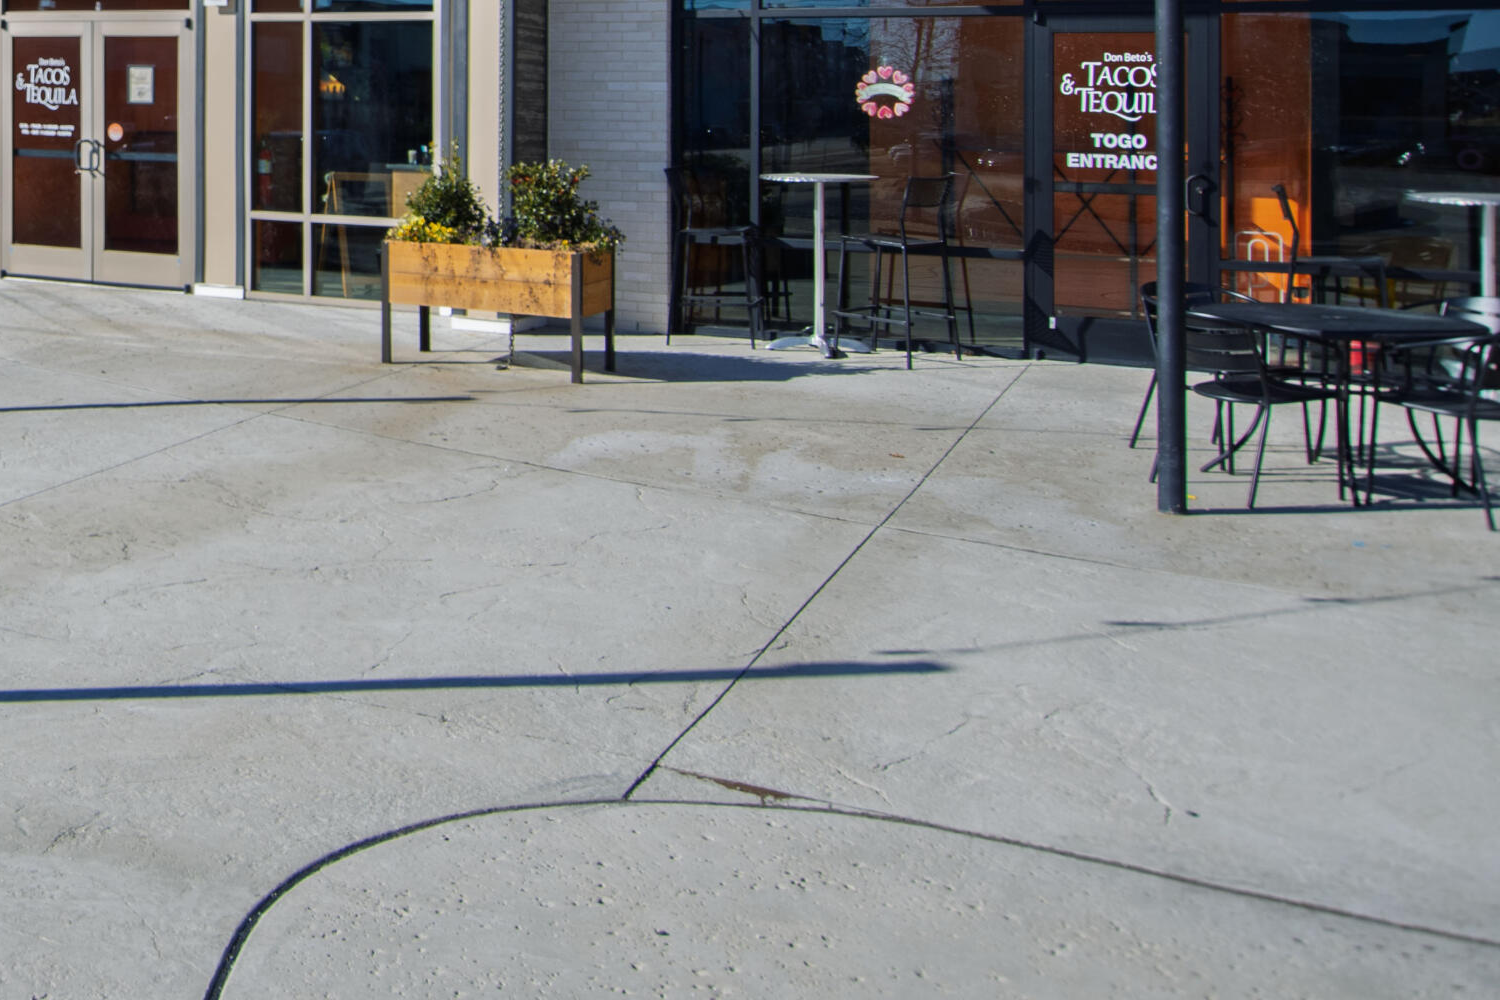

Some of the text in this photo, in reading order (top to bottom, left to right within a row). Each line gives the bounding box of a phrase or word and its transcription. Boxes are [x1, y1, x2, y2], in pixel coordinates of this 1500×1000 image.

[1103, 51, 1153, 62] Don Beto's
[26, 64, 71, 86] TACOS
[15, 72, 79, 111] & TEQUILA
[1060, 73, 1157, 121] & TEQUIL
[1090, 133, 1148, 149] TOGO
[1066, 152, 1158, 170] ENTRANC
